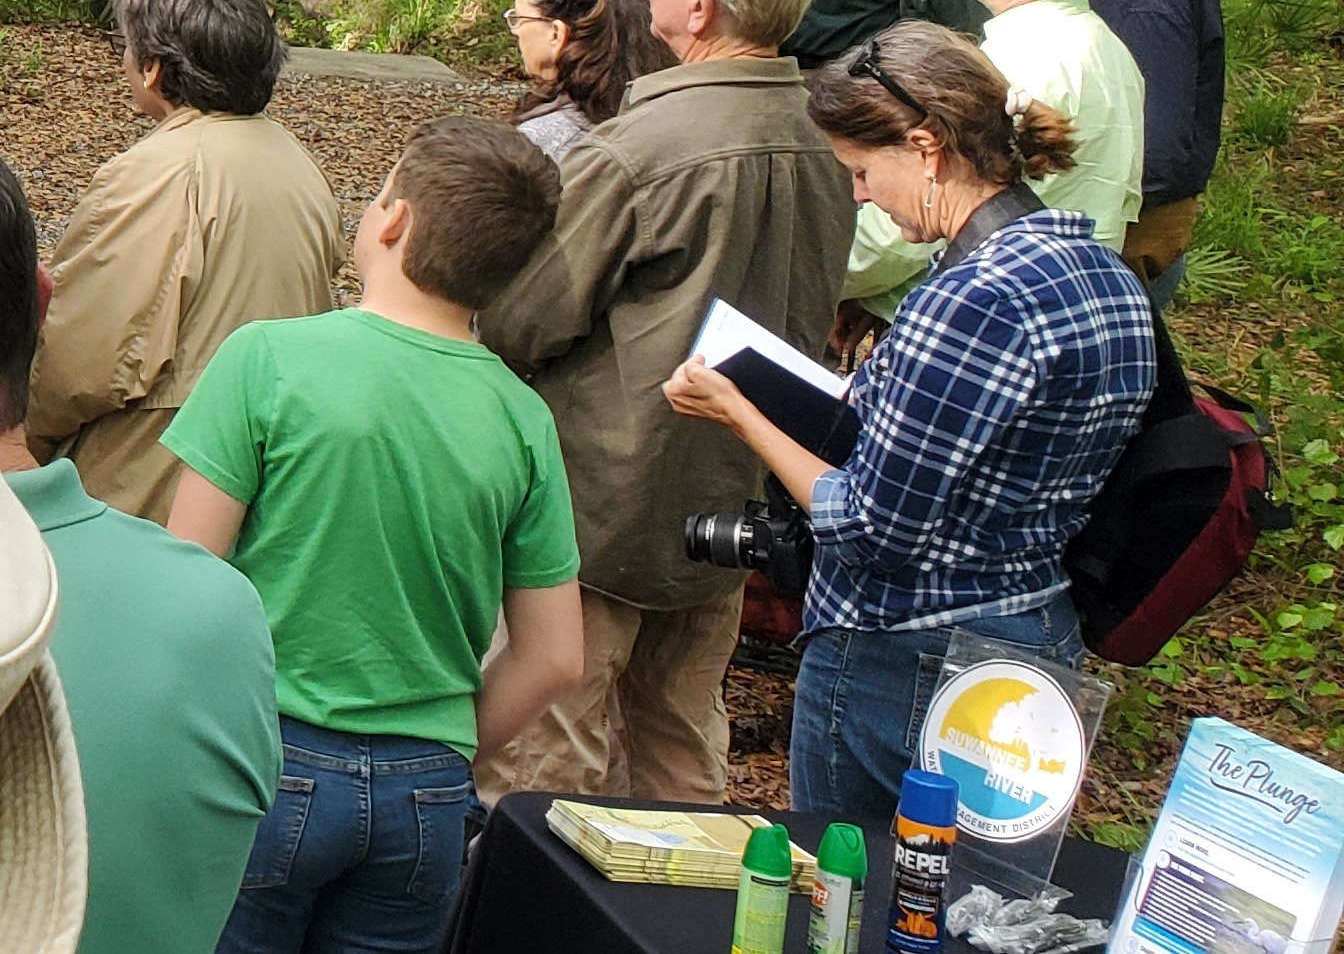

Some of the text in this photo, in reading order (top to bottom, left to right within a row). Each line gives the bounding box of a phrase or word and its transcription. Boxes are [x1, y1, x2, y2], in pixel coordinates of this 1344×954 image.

[945, 726, 1027, 773] SUWANNEE
[927, 750, 1056, 834] WAT AGEMENT DISTRICT
[983, 770, 1034, 806] RIVER
[1208, 743, 1245, 780] The
[1242, 760, 1322, 825] Plunge
[894, 843, 950, 874] REPEL
